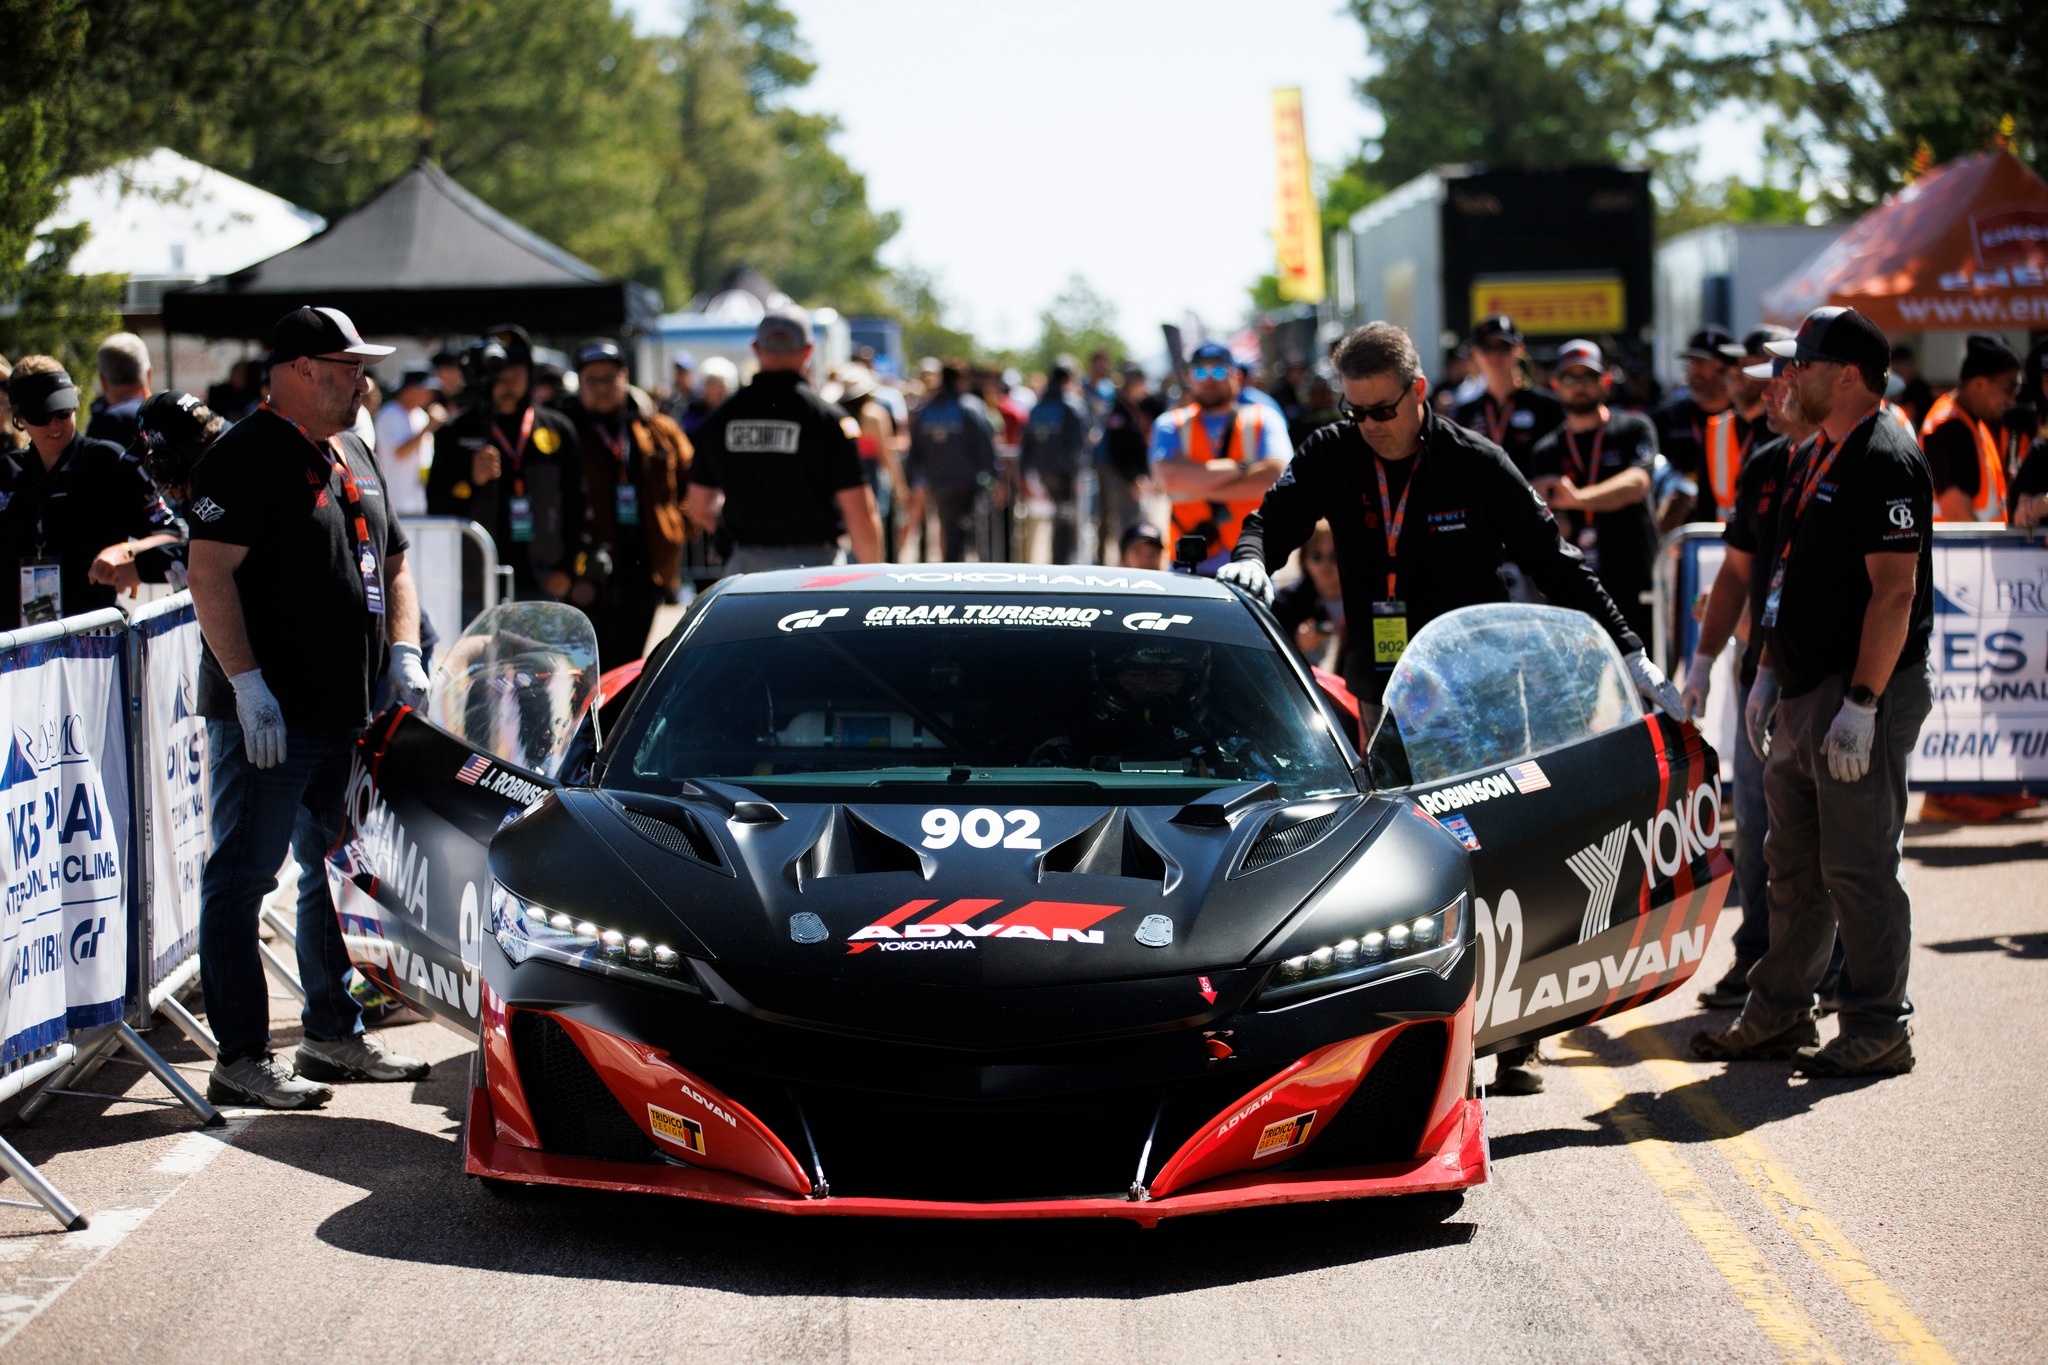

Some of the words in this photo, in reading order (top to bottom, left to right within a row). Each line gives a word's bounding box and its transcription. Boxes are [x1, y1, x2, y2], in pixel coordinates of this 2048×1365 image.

[731, 423, 797, 449] SECURITY
[885, 573, 1167, 592] YOKOHAMA
[865, 605, 956, 621] GRAN
[1003, 618, 1092, 628] SIMULATOR
[1377, 640, 1405, 654] 902
[1929, 631, 2028, 675] ES
[1934, 680, 2048, 703] ATIONAL
[1922, 730, 2000, 760] GRAN
[1417, 773, 1516, 816] ROBINSON
[920, 808, 1042, 850] 902
[847, 923, 1104, 944] ADVAN
[877, 939, 977, 953] YOKOHAMA
[343, 917, 461, 1010] ADVAN
[1523, 925, 1706, 1018] ADVAN
[1200, 977, 1212, 994] TOW
[681, 1084, 737, 1128] ADVAN
[1217, 1091, 1274, 1139] ADVAN
[650, 1109, 682, 1129] TRIDICO
[652, 1120, 684, 1138] DESIGN
[1263, 1121, 1295, 1140] TRIDICO
[1259, 1133, 1291, 1150] DESIGN
